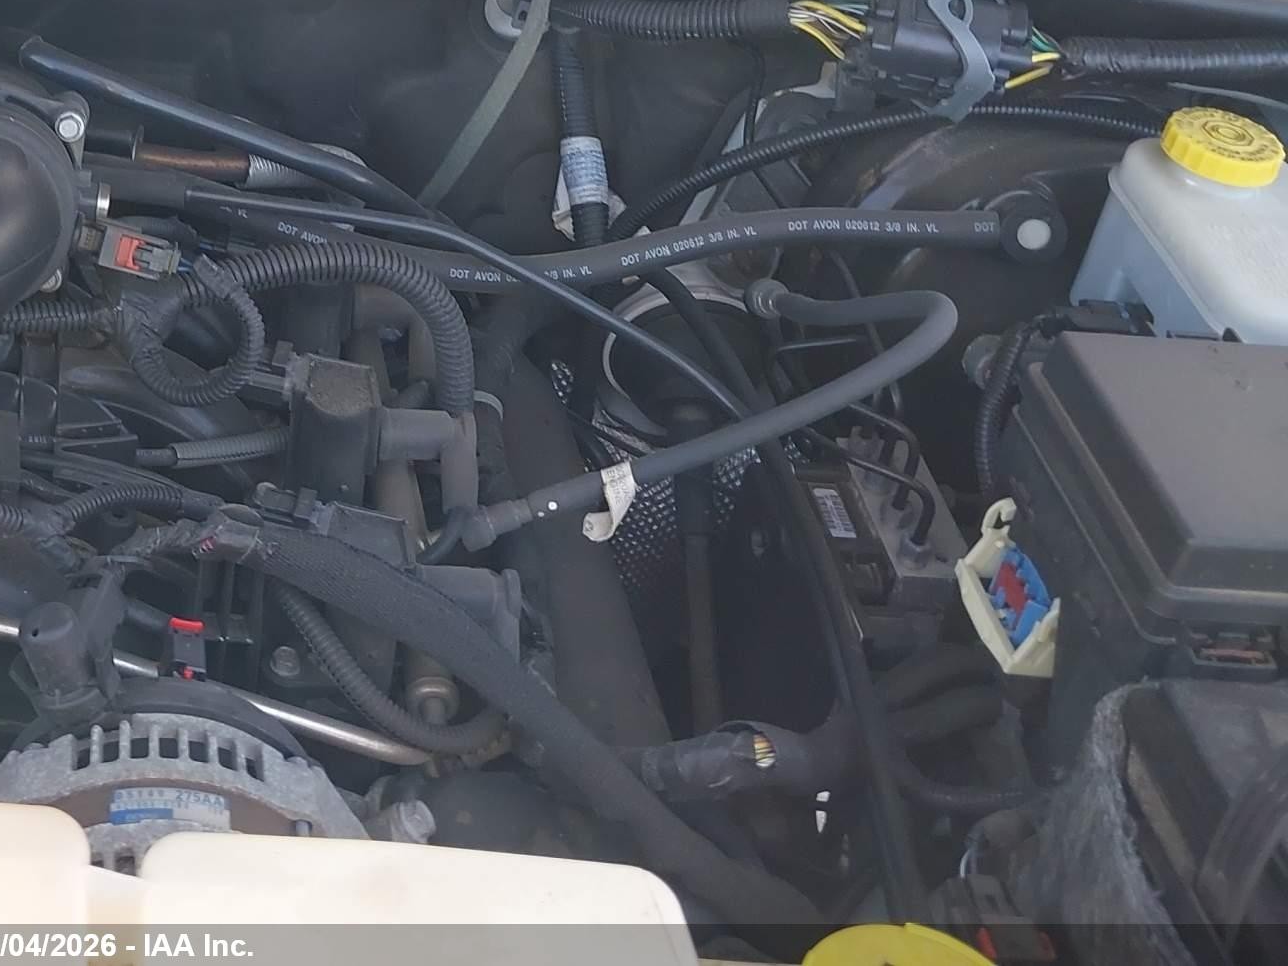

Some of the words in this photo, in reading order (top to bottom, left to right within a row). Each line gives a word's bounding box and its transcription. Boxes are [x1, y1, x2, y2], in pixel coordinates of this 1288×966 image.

[277, 221, 298, 237] DOT
[788, 220, 809, 231] DOT
[813, 219, 840, 231] AVON
[906, 222, 921, 233] IN.
[925, 222, 940, 234] VL
[974, 221, 996, 233] DOT
[620, 253, 641, 267] DOT
[644, 244, 671, 262] AVON
[708, 231, 724, 244] 3/8
[727, 227, 741, 240] IN.
[743, 225, 758, 237] VL
[449, 268, 470, 279] DOT
[474, 271, 502, 283] AVON
[562, 267, 577, 279] IN.
[579, 265, 593, 277] VL
[175, 789, 224, 807] 275AA
